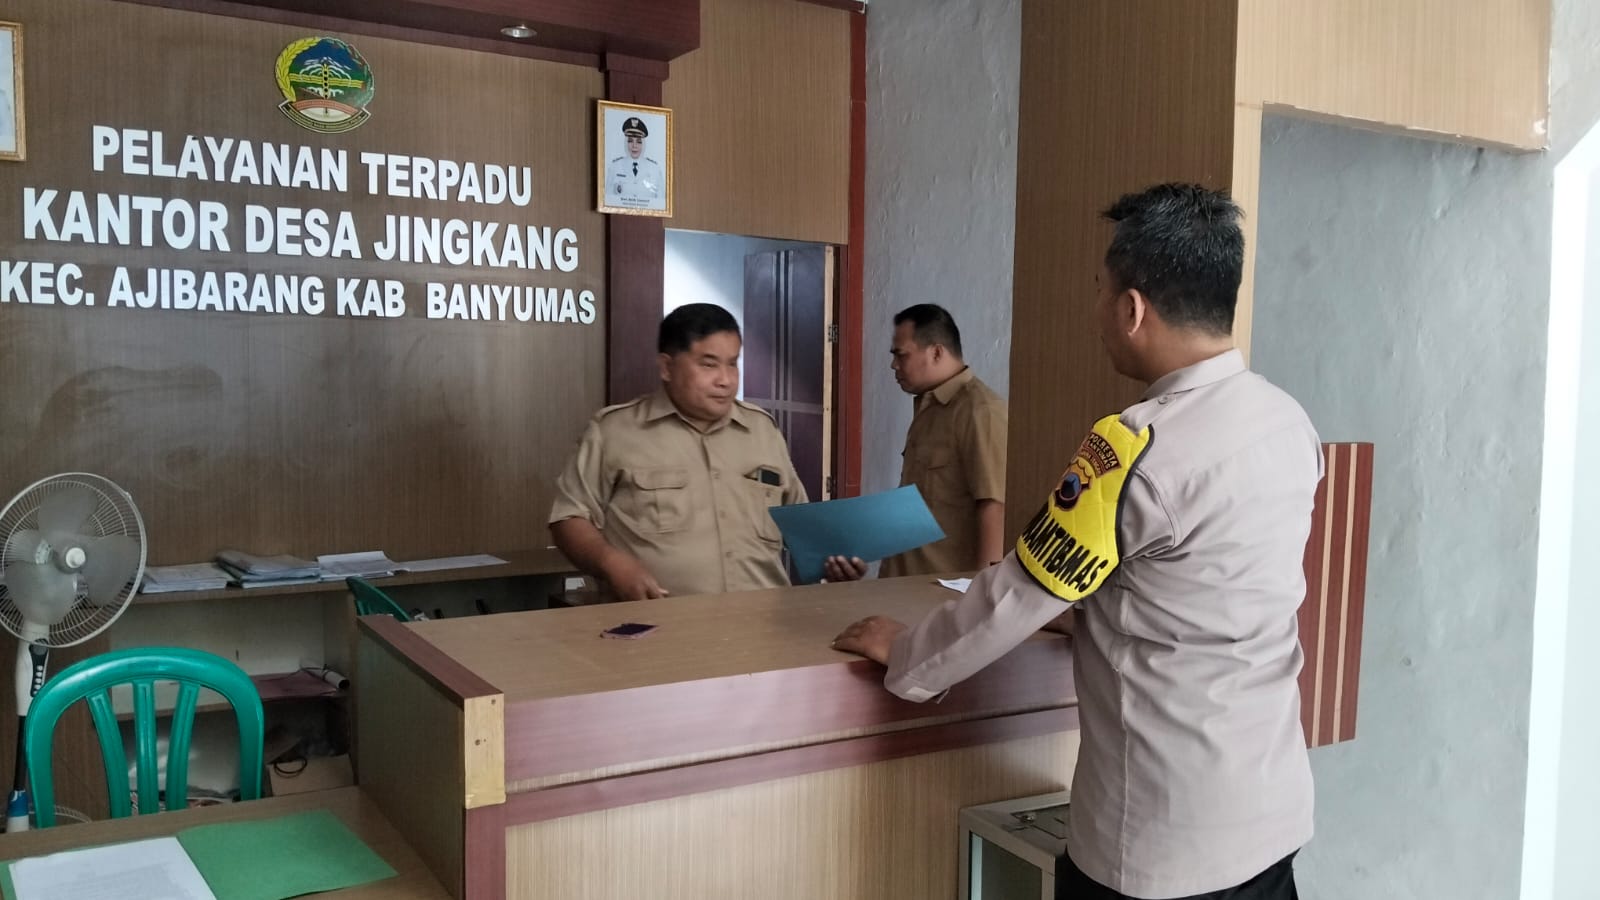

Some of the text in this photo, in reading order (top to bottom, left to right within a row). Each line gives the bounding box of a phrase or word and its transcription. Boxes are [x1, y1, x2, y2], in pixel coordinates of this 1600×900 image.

[92, 125, 532, 207] PELAYANAN TERPADU
[23, 187, 579, 272] KANTOR DESA JINGKANG
[0, 260, 596, 325] KEC. AJIBARANG KAB BANYUMAS
